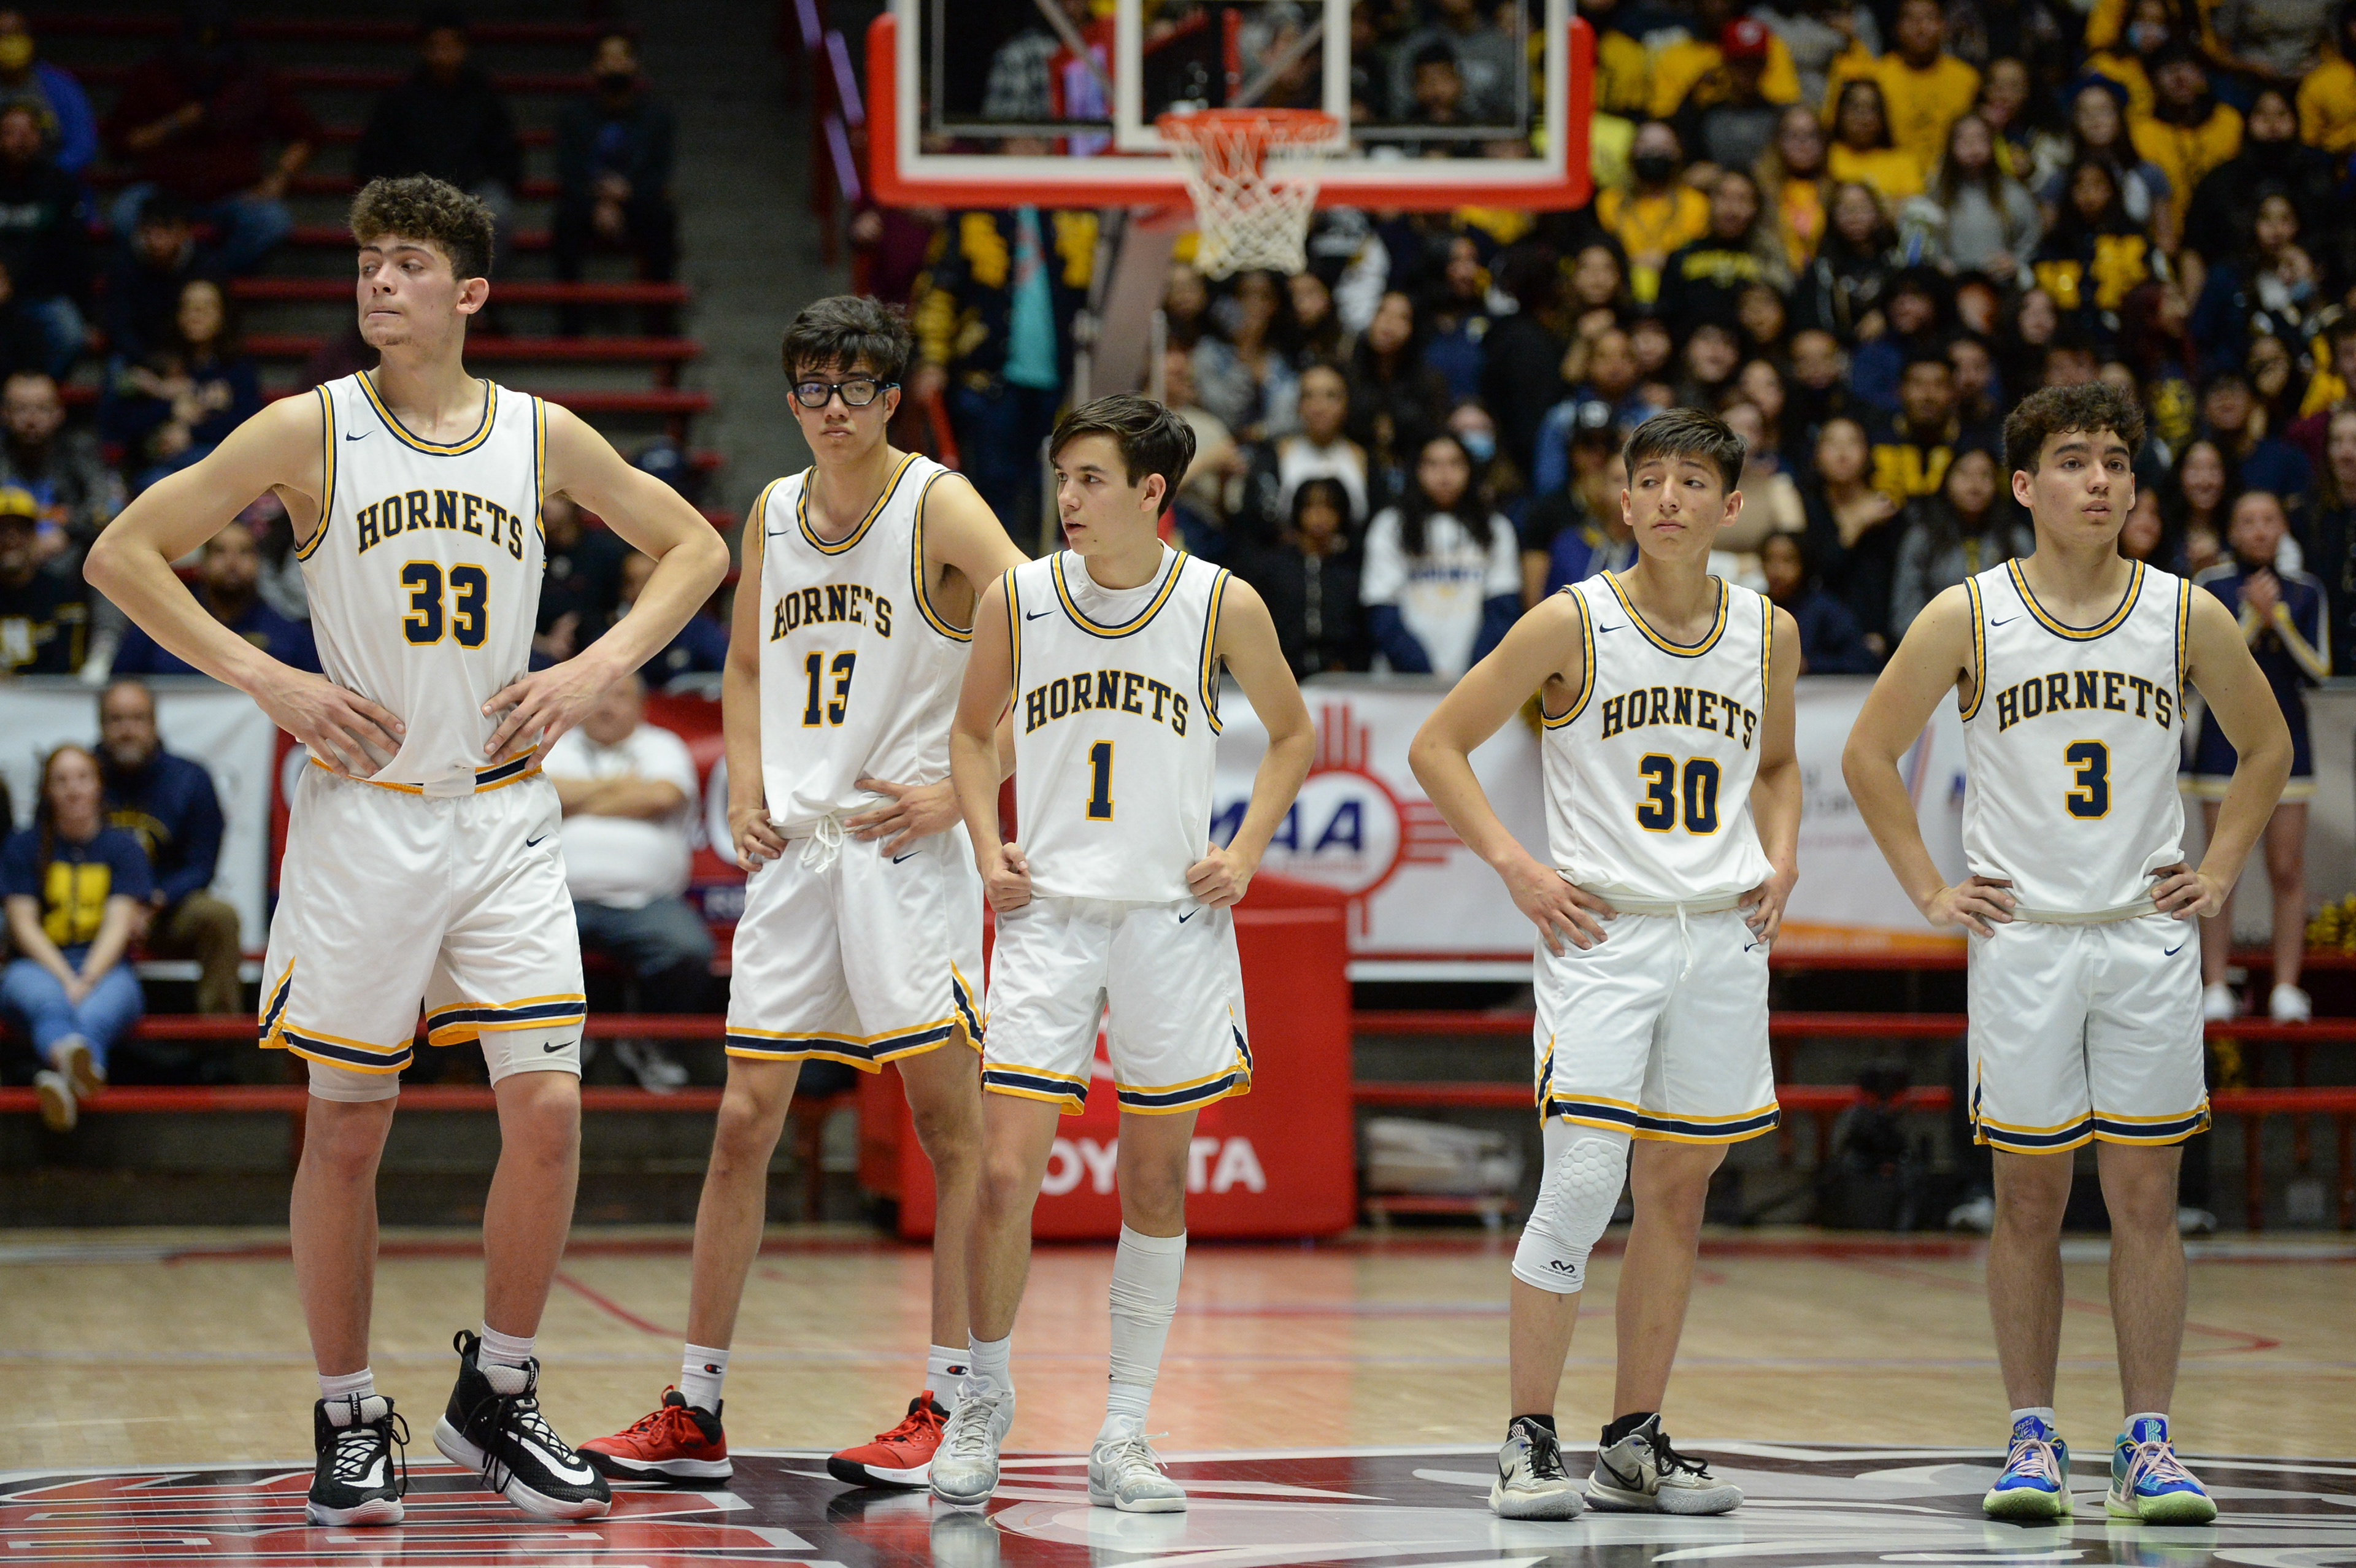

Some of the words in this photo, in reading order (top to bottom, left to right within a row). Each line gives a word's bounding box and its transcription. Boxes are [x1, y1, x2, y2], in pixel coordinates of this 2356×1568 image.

[356, 488, 523, 561] HORNETS
[399, 559, 490, 650] 33
[801, 649, 857, 728] 13
[1025, 669, 1189, 737] HORNETS
[1601, 685, 1757, 751] HORNETS
[1995, 669, 2173, 734] HORNETS
[1085, 739, 1114, 821] 1
[1635, 751, 1722, 836] 30
[2063, 739, 2111, 821] 3
[1039, 1135, 1266, 1196] OYTA
